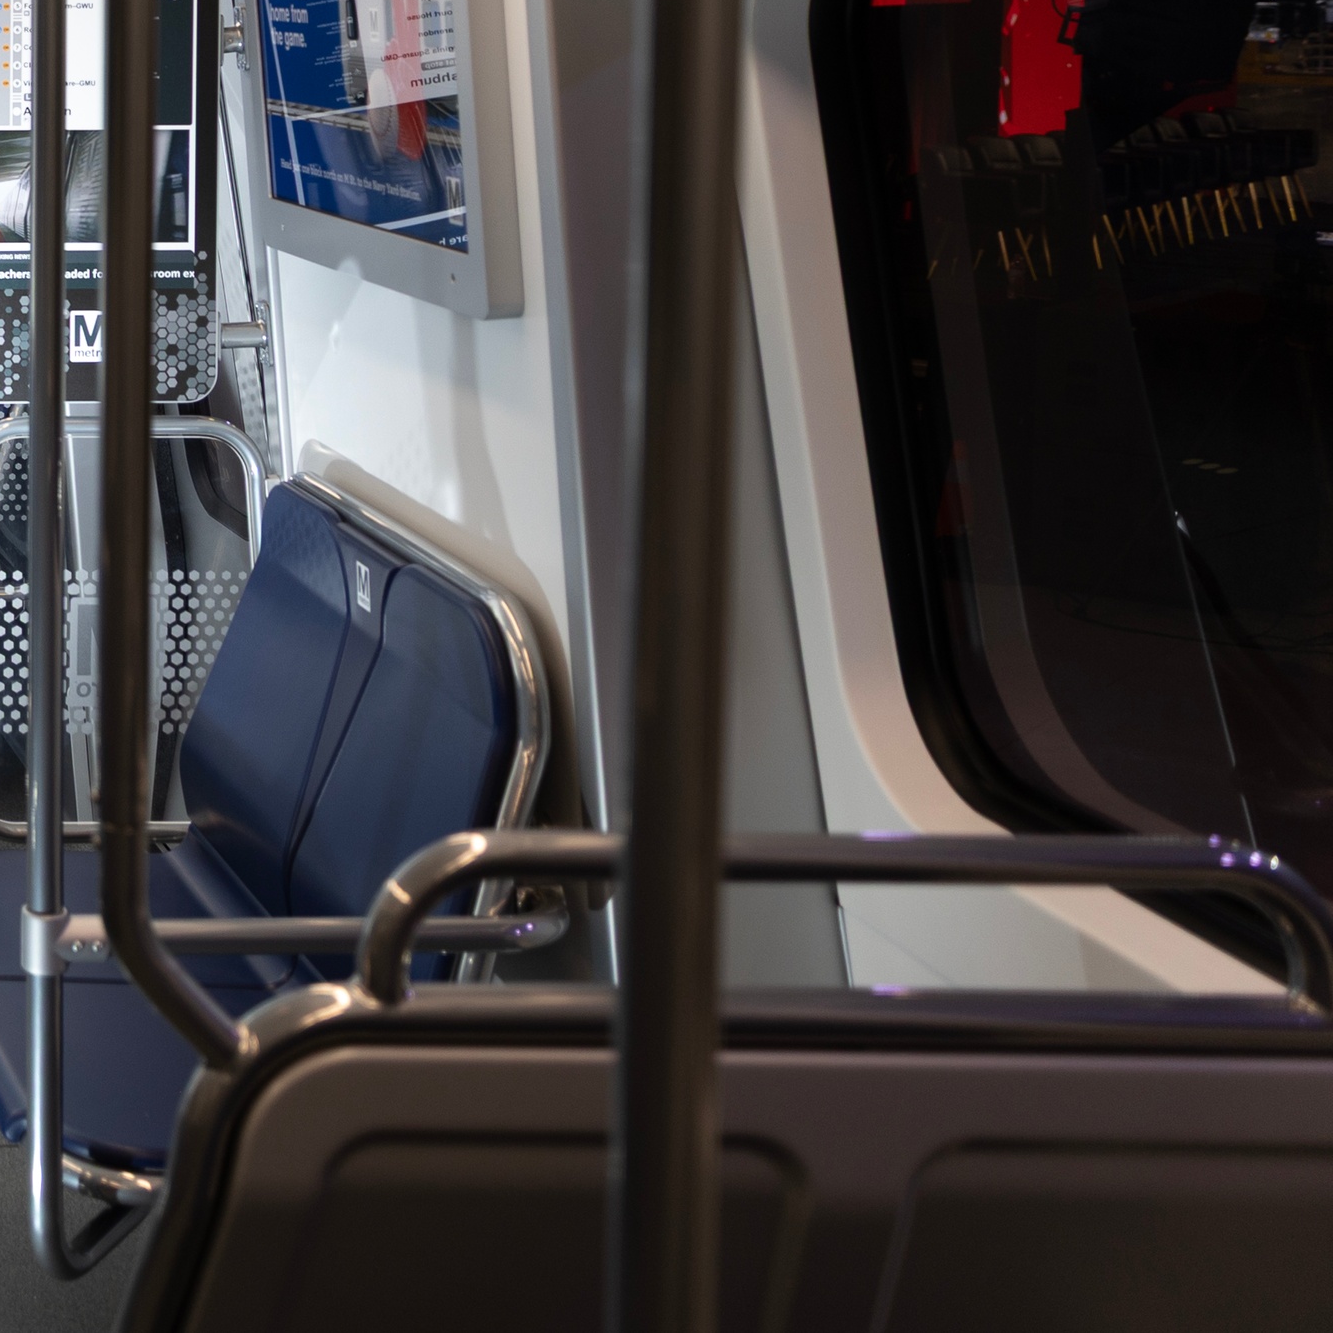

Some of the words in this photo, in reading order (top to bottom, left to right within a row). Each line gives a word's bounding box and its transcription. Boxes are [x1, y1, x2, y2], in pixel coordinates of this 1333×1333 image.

[269, 4, 290, 23] home
[290, 7, 309, 24] from
[284, 32, 308, 51] game.
[65, 269, 88, 279] aded
[75, 349, 102, 357] metr
